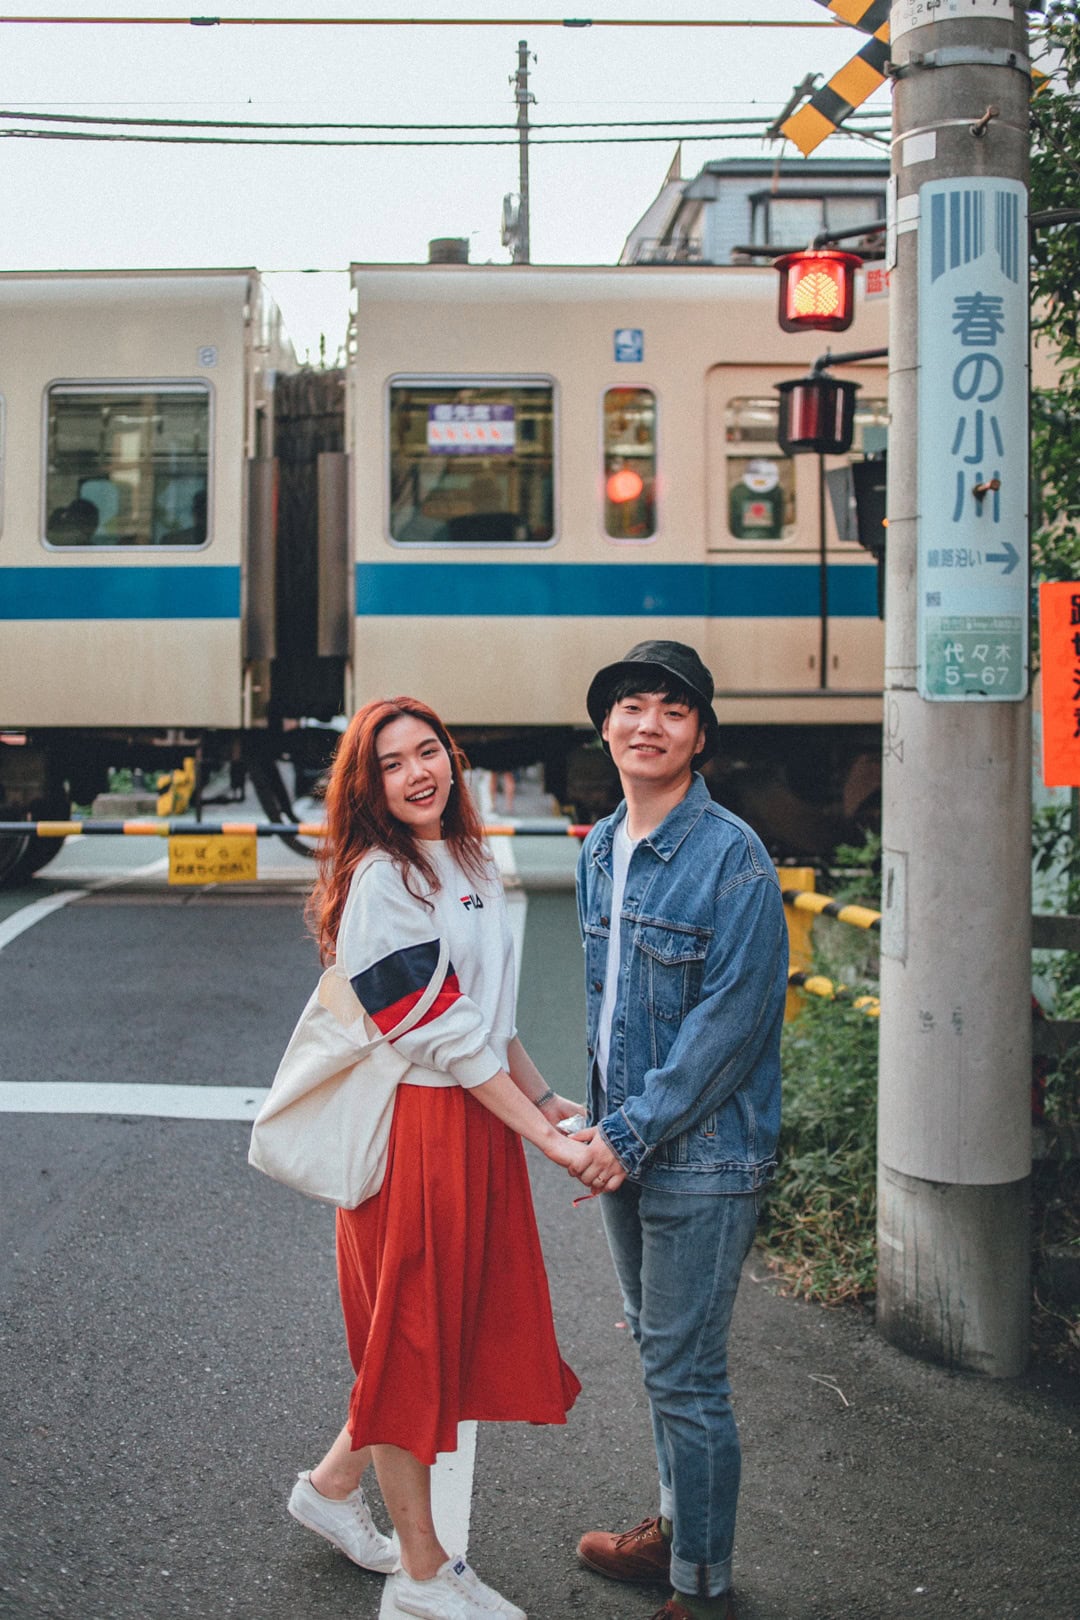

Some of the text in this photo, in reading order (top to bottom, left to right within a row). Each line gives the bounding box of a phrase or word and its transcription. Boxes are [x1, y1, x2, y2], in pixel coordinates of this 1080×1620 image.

[952, 291, 1004, 523] 春の小川
[944, 641, 1011, 663] 代々木
[945, 665, 1009, 686] 5-67
[460, 893, 484, 911] FILA
